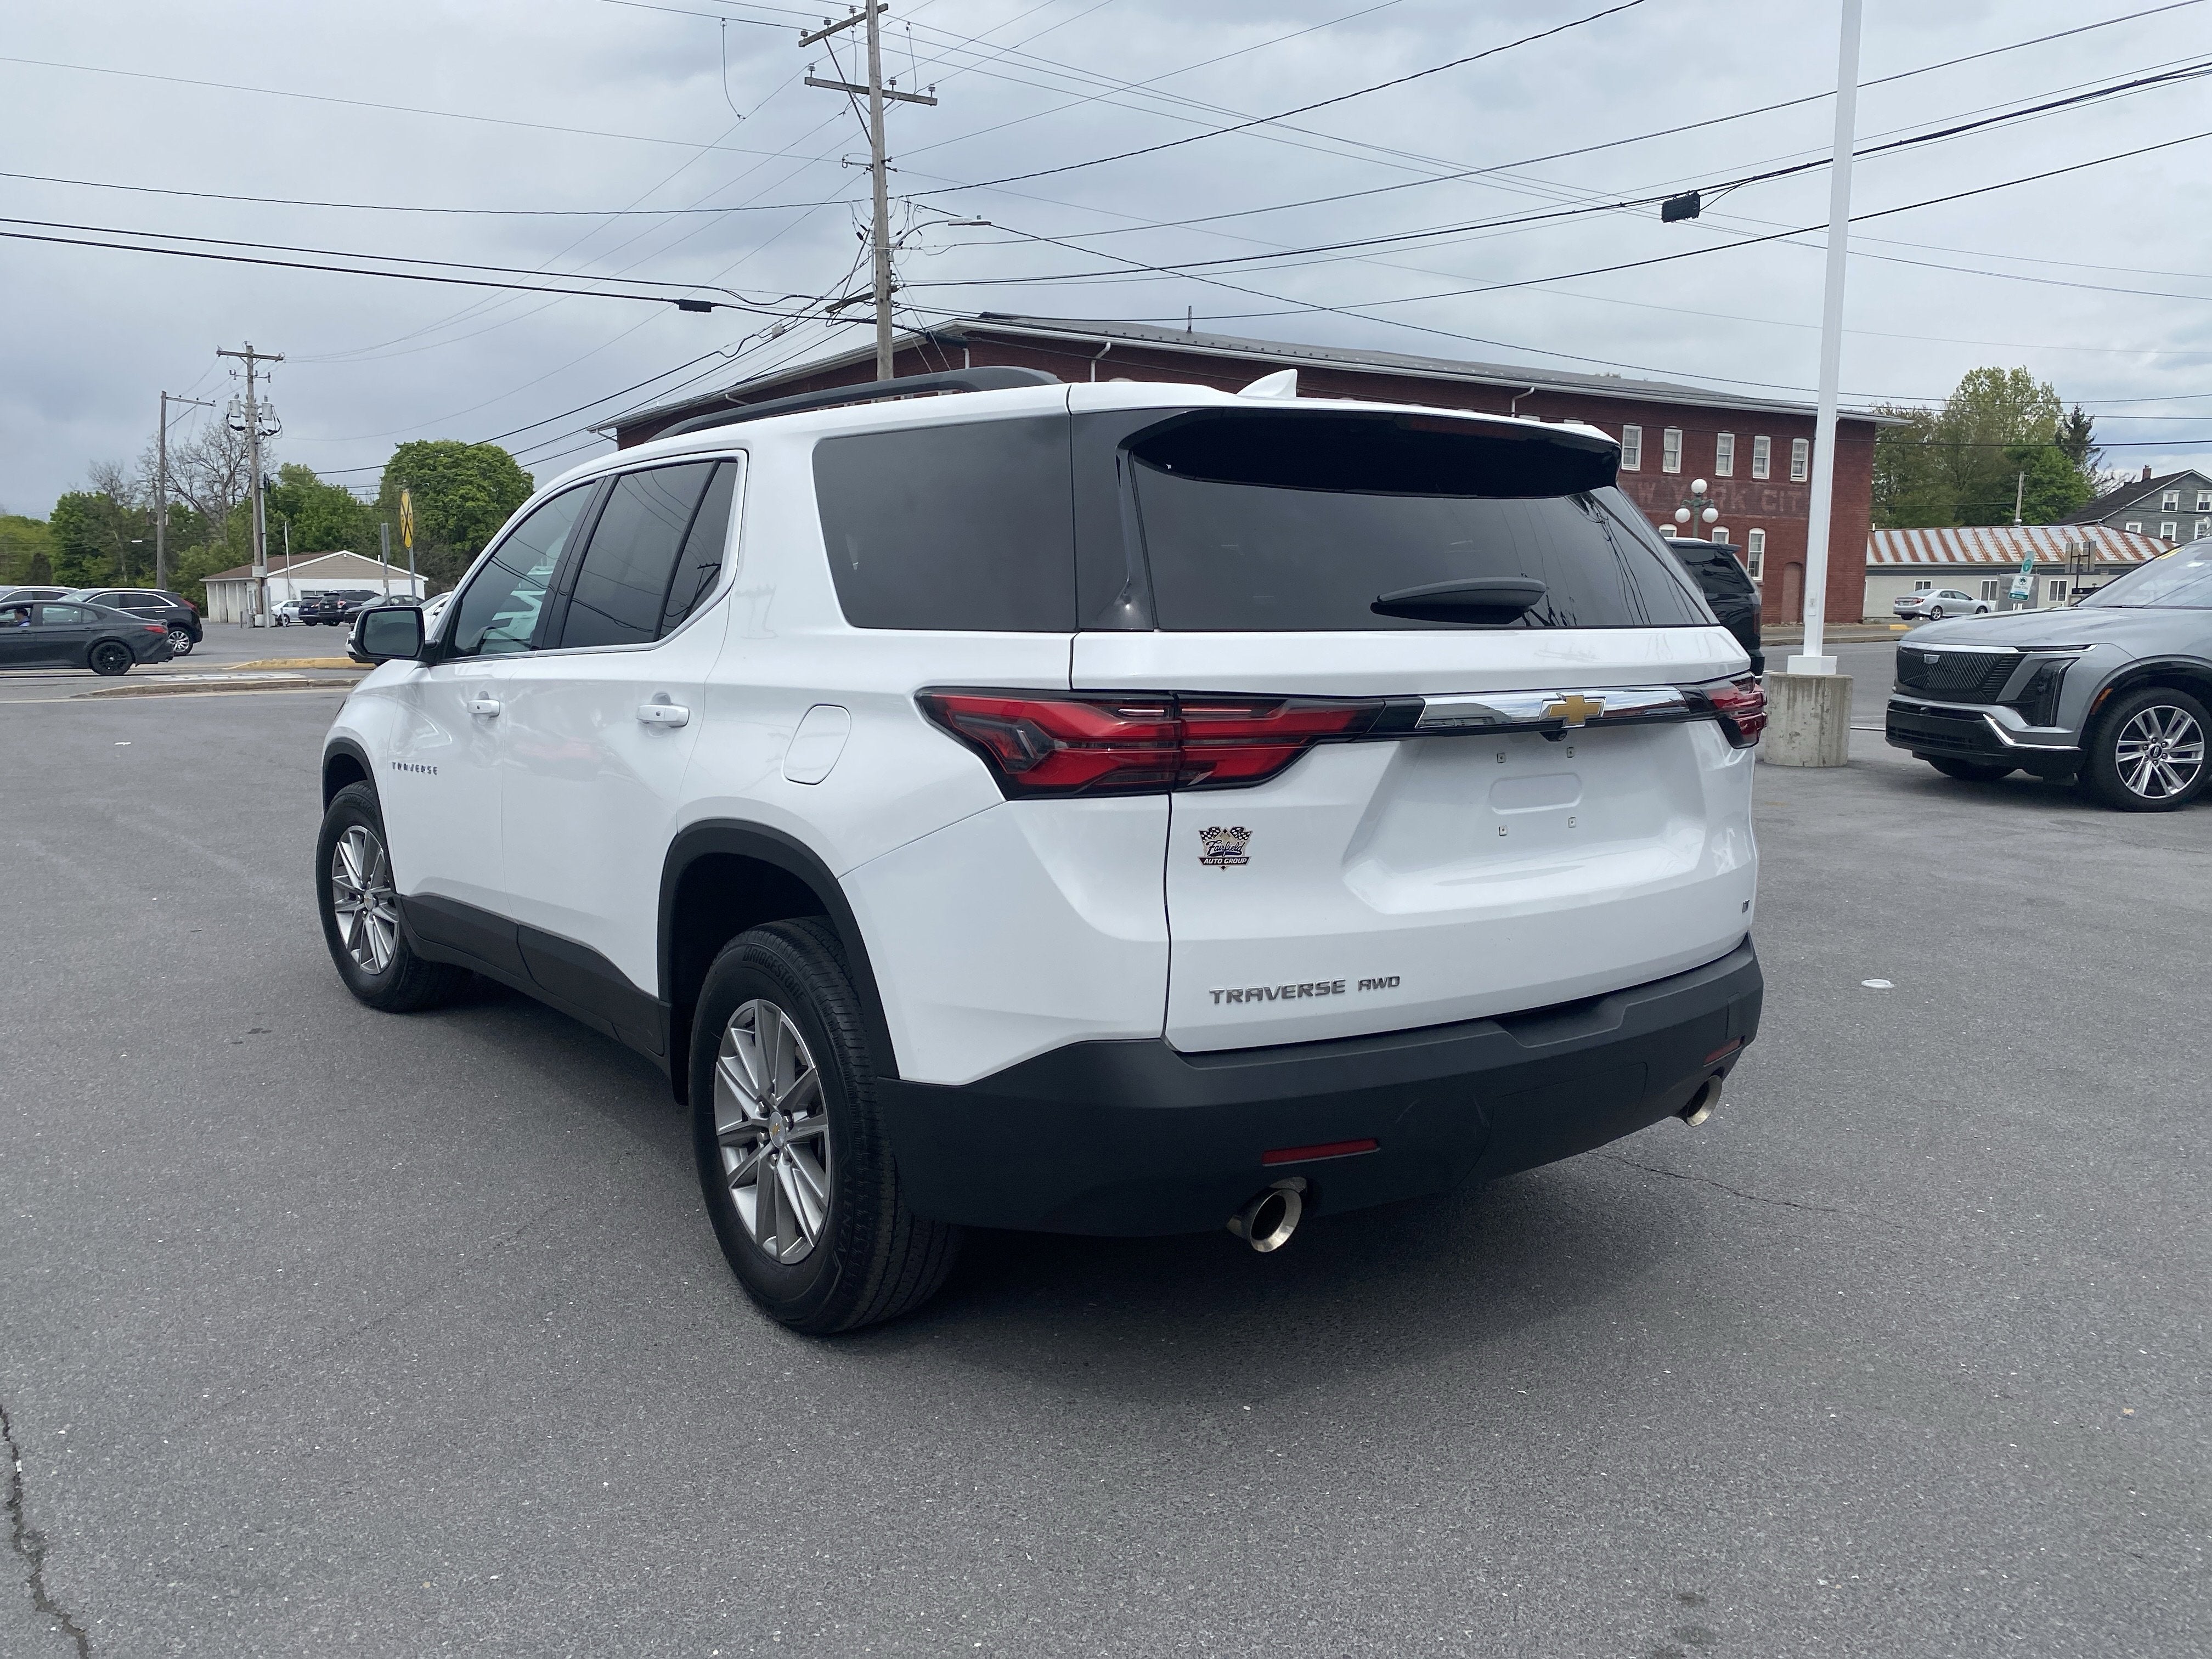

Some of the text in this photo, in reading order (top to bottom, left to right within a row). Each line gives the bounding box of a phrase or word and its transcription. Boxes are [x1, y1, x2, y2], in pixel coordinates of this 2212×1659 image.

[1672, 484, 1746, 509] YRK
[1760, 489, 1803, 512] CIT
[392, 761, 437, 775] TRAVERSE
[1205, 839, 1246, 856] Fairfield
[741, 945, 806, 1005] BRIDGESTONE
[1209, 975, 1401, 1005] TRAVERSE AWD
